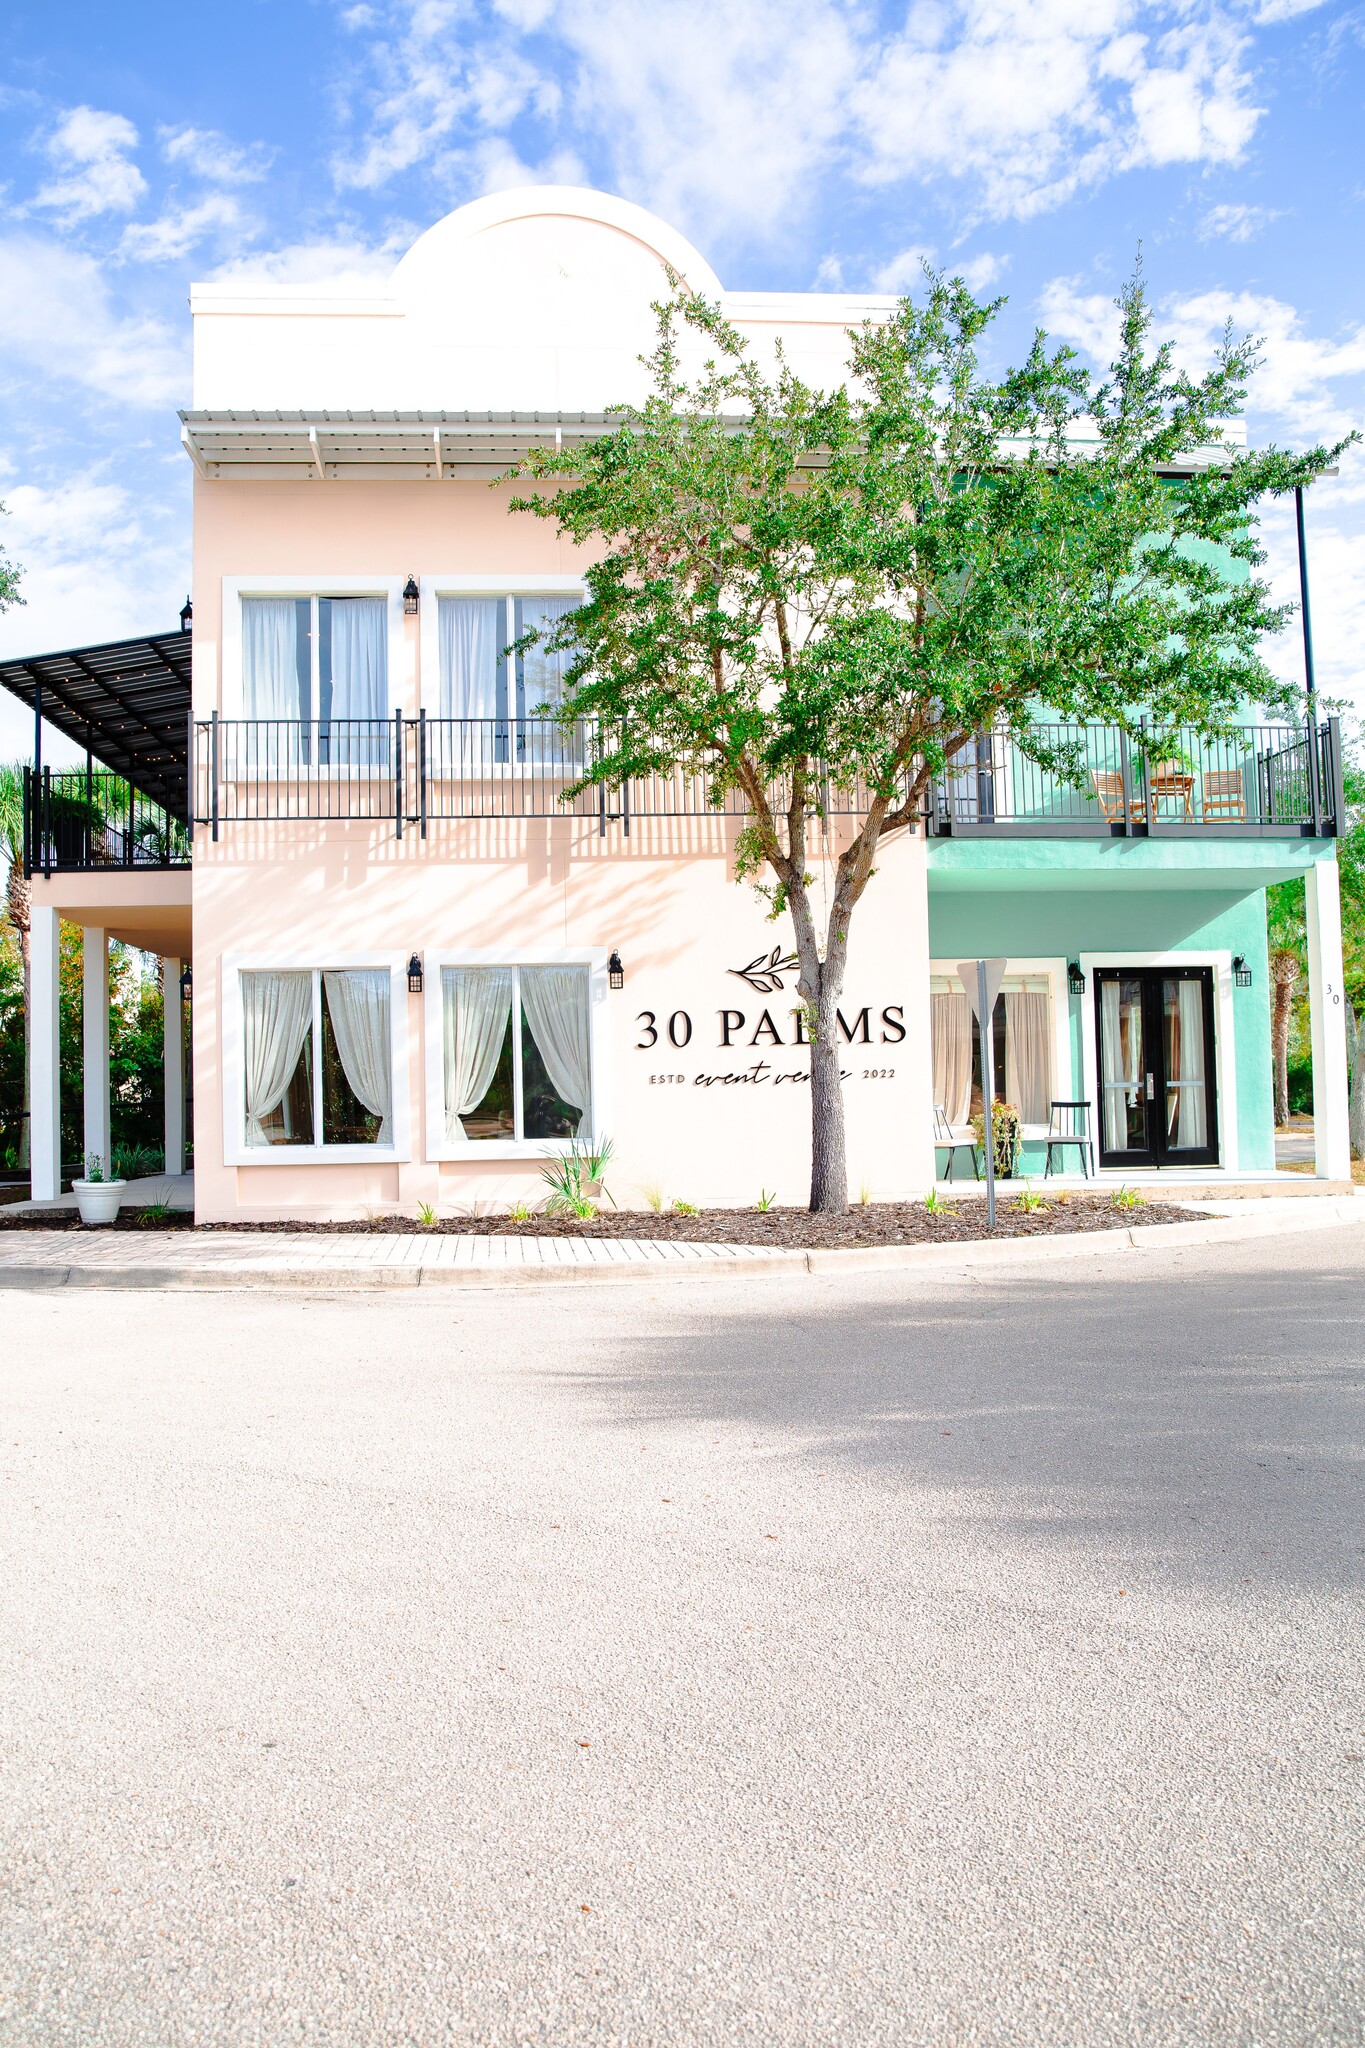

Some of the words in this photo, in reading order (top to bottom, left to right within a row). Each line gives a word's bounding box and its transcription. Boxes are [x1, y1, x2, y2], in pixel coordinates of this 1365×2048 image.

[635, 1010, 693, 1048] 30
[718, 1005, 907, 1046] PALMS
[650, 1074, 686, 1084] ESTD
[695, 1060, 771, 1086] event
[862, 1069, 896, 1079] 2022
